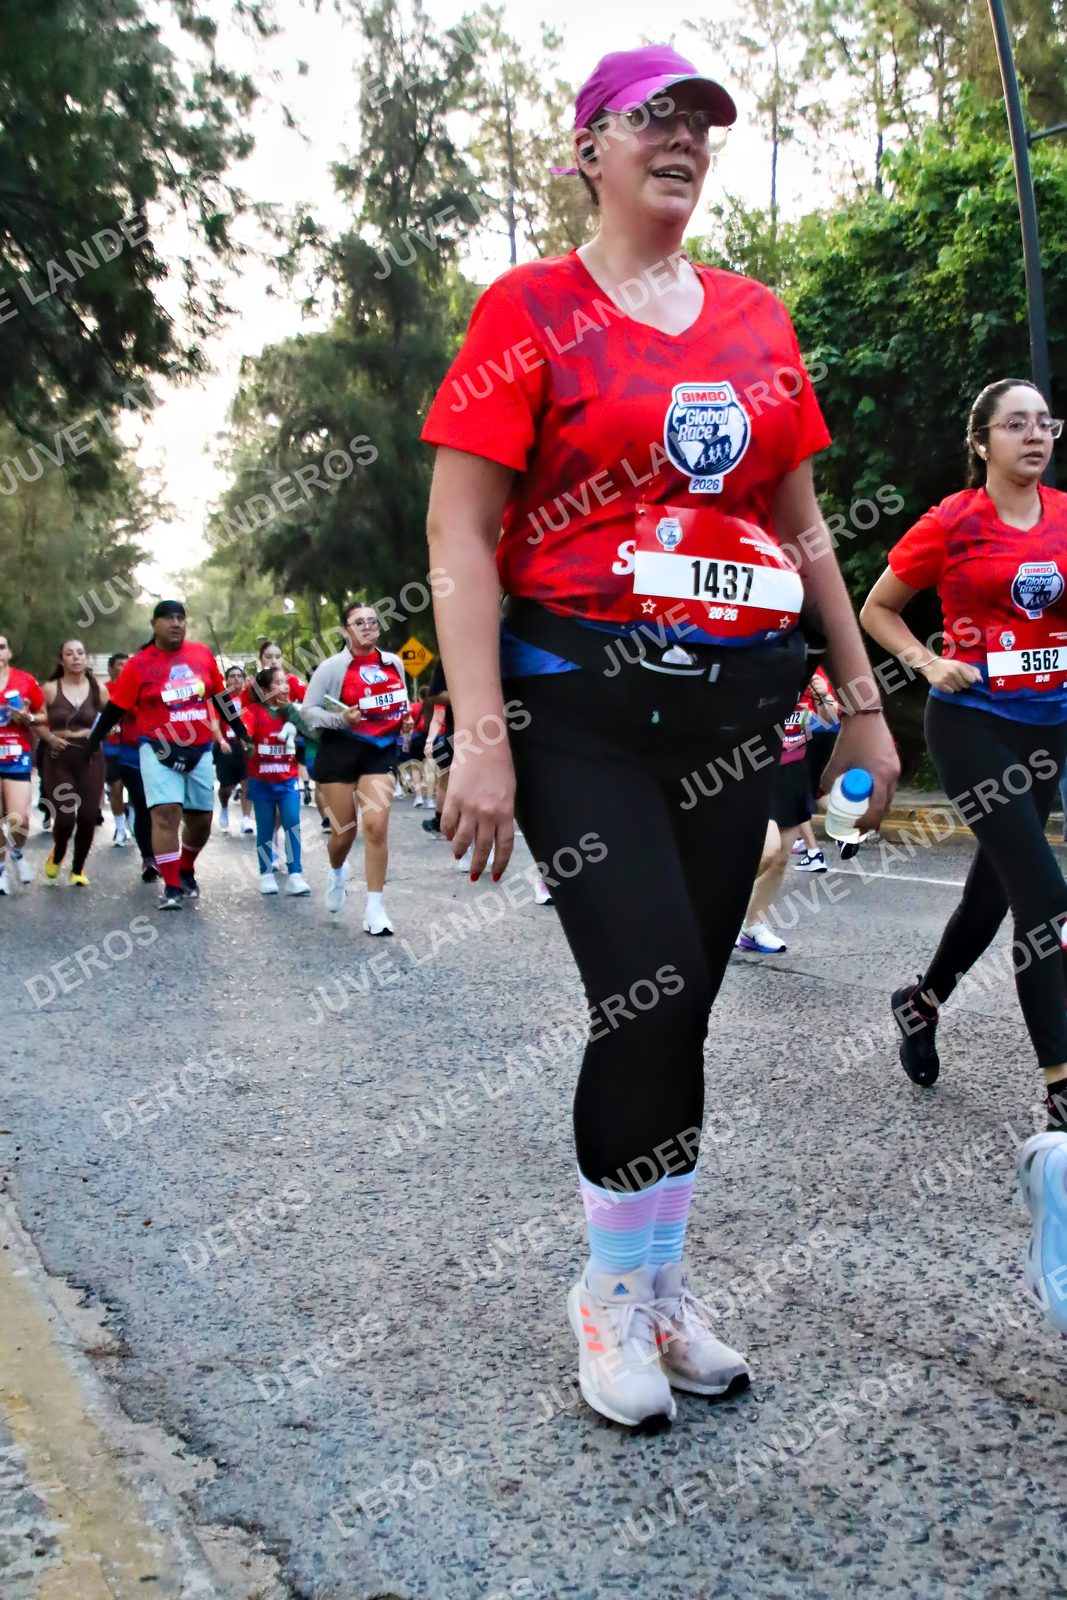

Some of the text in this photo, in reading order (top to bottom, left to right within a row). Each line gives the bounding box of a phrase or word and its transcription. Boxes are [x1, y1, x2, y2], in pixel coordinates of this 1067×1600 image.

[681, 391, 727, 402] BIMBO
[685, 408, 729, 426] Global
[678, 424, 714, 441] Race
[692, 479, 720, 491] 2026
[691, 560, 754, 602] 1437
[1025, 576, 1053, 587] Global
[1019, 585, 1041, 594] Race
[1021, 649, 1059, 672] 3562
[375, 694, 394, 706] 1643
